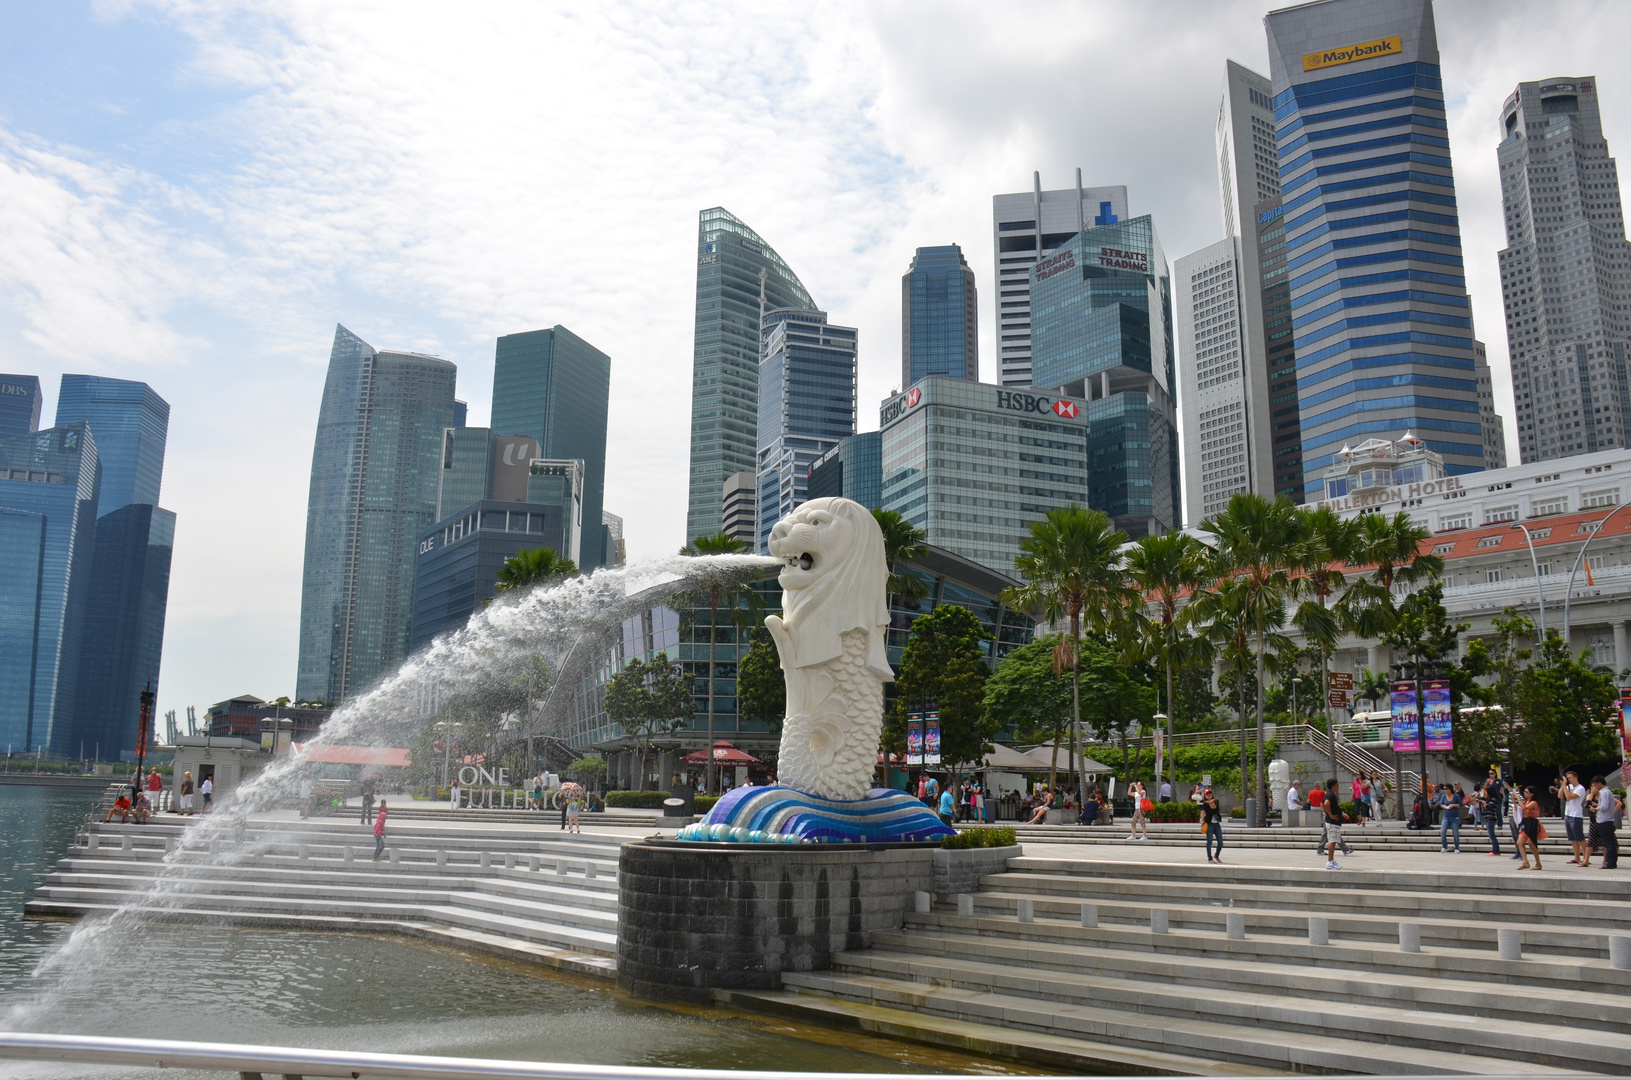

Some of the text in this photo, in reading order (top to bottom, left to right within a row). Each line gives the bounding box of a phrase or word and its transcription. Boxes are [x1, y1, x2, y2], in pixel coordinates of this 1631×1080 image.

[1323, 40, 1392, 63] Maybank
[1036, 250, 1073, 272] STRAITS
[1099, 256, 1148, 272] TRADING
[1101, 247, 1148, 261] STRAITS
[1035, 258, 1075, 281] TRADING
[1, 383, 28, 396] DBS
[879, 393, 907, 428] HSBC
[996, 389, 1050, 415] HSBC
[1408, 476, 1464, 498] HOTEL
[420, 536, 434, 554] OUE
[458, 766, 510, 786] ONE
